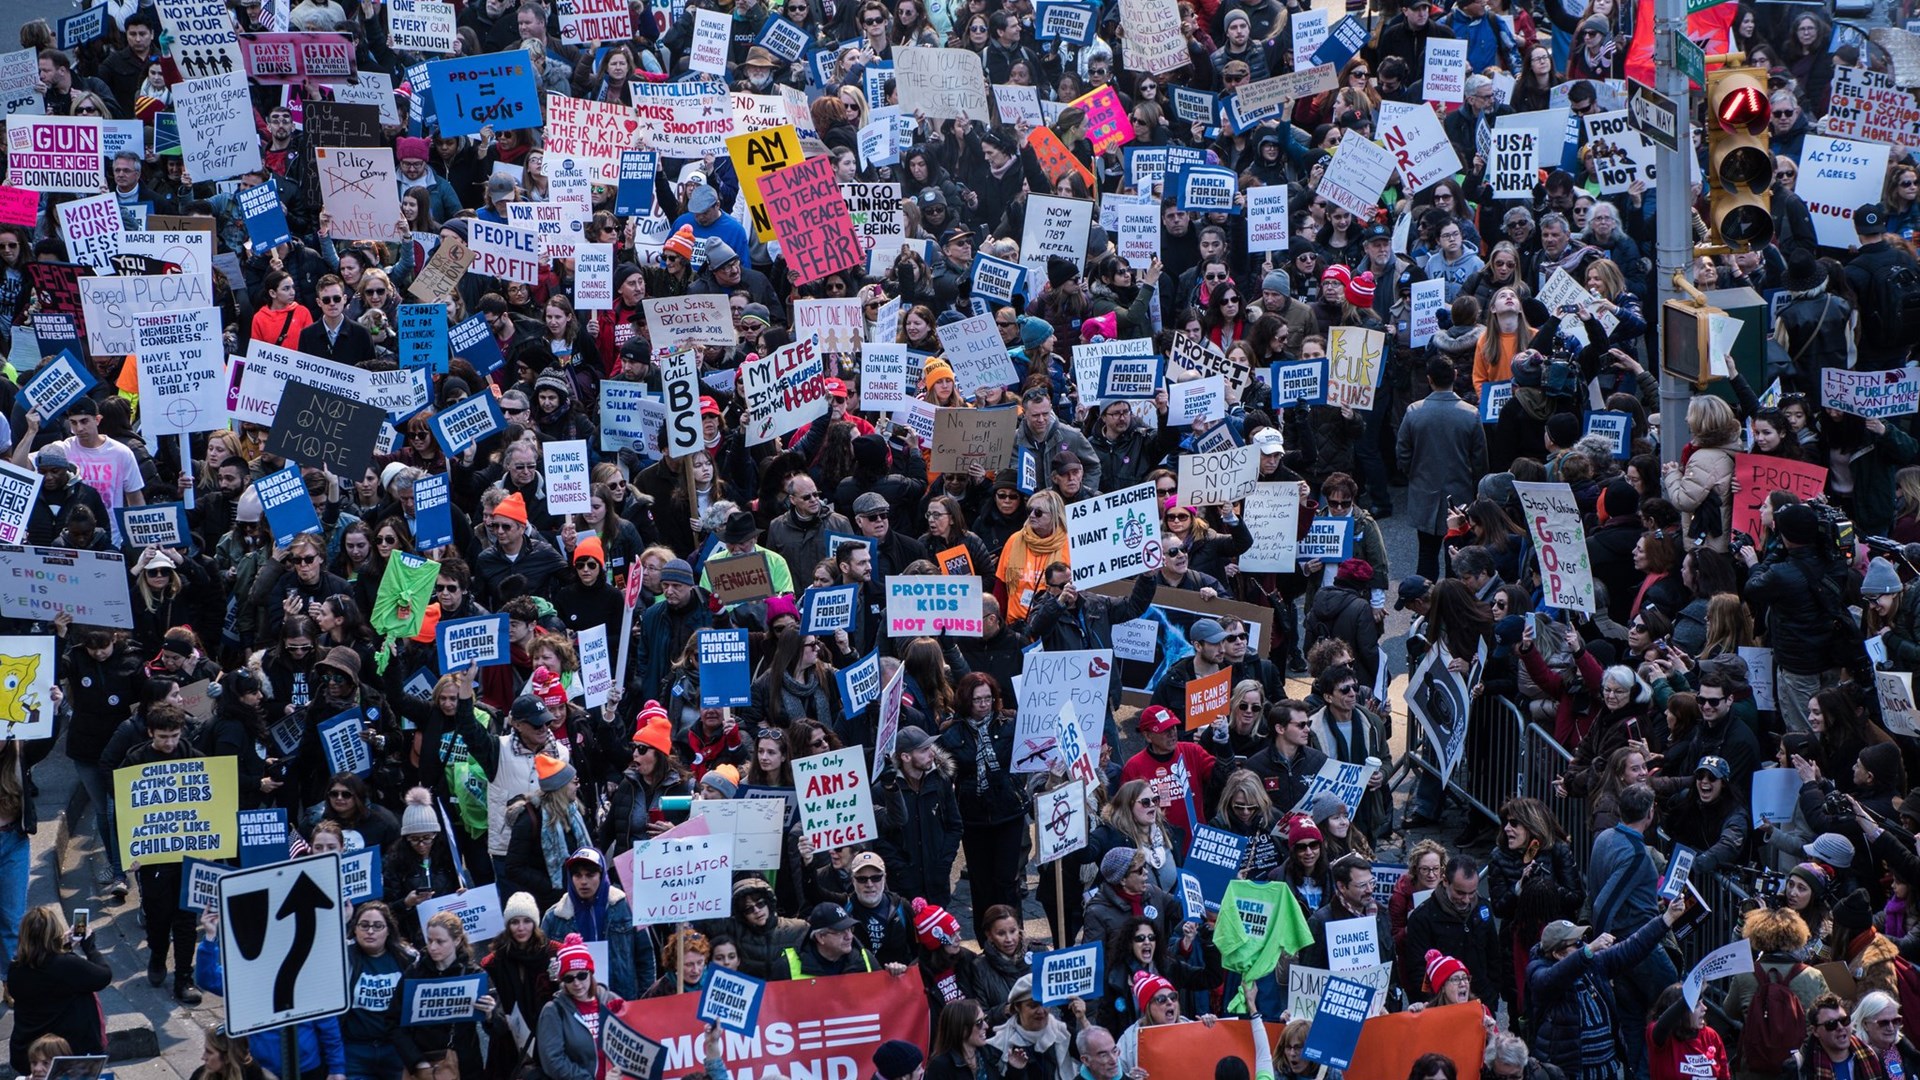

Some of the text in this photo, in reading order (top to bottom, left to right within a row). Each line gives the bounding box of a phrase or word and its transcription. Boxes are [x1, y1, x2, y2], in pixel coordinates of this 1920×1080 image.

[164, 5, 226, 19] NO PLACE
[1050, 9, 1081, 20] MARCH
[177, 19, 222, 30] IN OUR
[393, 20, 450, 33] EVERY GUN
[701, 20, 725, 30] CHANGE
[180, 32, 237, 45] SCHOOLS
[394, 35, 449, 49] #ENOUGH
[254, 43, 289, 55] GAYS
[698, 44, 721, 55] CHANGE
[1433, 48, 1460, 58] CHANGE
[257, 54, 290, 63] AGAINST
[693, 54, 724, 65] CONGRESS
[1429, 58, 1463, 68] GUN LAWS
[257, 63, 292, 73] GUNS
[189, 75, 231, 93] OWNING
[1431, 74, 1457, 83] CHANGE
[1426, 83, 1461, 92] CONGRESS
[1835, 82, 1908, 106] FEEL LUCKY
[1832, 95, 1872, 111] GO TO
[549, 109, 618, 130] THE NRA
[1635, 100, 1673, 130] ONE WAY
[1830, 106, 1908, 129] NOT LUCKY
[197, 124, 224, 141] NOT
[551, 123, 633, 145] THEIR KIDS
[1829, 118, 1893, 142] GET HOME
[34, 125, 97, 151] GUN
[652, 134, 721, 144] ARE AMERICAN
[1497, 134, 1533, 151] USA
[187, 142, 247, 162] GOD GIVEN
[544, 137, 612, 158] MORE THAN
[748, 132, 788, 165] AM
[10, 154, 98, 169] VIOLENCE
[202, 155, 236, 173] RIGHT
[1497, 153, 1532, 170] NOT
[1809, 151, 1870, 166] ACTIVIST
[25, 171, 99, 187] CONTAGIOUS
[1191, 177, 1225, 187] MARCH
[1497, 173, 1534, 191] NRA
[1817, 169, 1856, 180] AGREES
[1254, 197, 1281, 206] CHANGE
[64, 200, 117, 224] MORE
[872, 211, 895, 223] NOT
[1047, 207, 1072, 217] NOW
[1251, 206, 1284, 216] GUN LAWS
[69, 216, 120, 239] GUNS
[864, 224, 900, 235] BEING
[1044, 218, 1071, 228] IS NOT
[1254, 222, 1281, 232] CHANGE
[126, 234, 202, 243] MARCH FOR OUR
[474, 223, 534, 253] PEOPLE
[1251, 231, 1286, 241] CONGRESS
[581, 254, 606, 262] CHANGE
[471, 250, 536, 282] PROFIT
[578, 264, 592, 272] GUN
[581, 281, 606, 289] CHANGE
[578, 290, 610, 299] CONGRESS
[139, 323, 209, 336] MEMBERS OF
[142, 350, 201, 364] HAVE YOU
[669, 355, 686, 367] WE
[749, 339, 815, 387] MY LIFE
[146, 362, 189, 374] REALLY
[664, 367, 692, 382] CALL
[1114, 364, 1148, 373] MARCH
[152, 370, 215, 385] READ YOUR
[1827, 371, 1880, 386] LISTEN
[1824, 390, 1917, 406] WE WANT MORE
[1855, 385, 1894, 397] PUBLIC
[1828, 399, 1913, 417] GUN CONTROL
[674, 412, 697, 447] S
[551, 452, 580, 462] CHANGE
[1192, 448, 1247, 475] BOOKS
[548, 463, 585, 473] GUN LAWS
[1205, 468, 1238, 489] NOT
[553, 482, 581, 492] CHANGE
[550, 492, 587, 503] CONGRESS
[1071, 486, 1155, 520] AS A TEACHER
[1522, 492, 1550, 512] Stop
[129, 513, 164, 524] MARCH
[1073, 552, 1142, 582] NOT A PIECE
[12, 567, 79, 584] ENOUGH
[892, 583, 970, 597] PROTECT
[917, 599, 958, 611] KIDS
[893, 618, 982, 632] NOT GUNS!
[449, 625, 487, 641] MARCH
[701, 632, 739, 642] MARCH
[1024, 656, 1081, 687] ARMS
[1026, 689, 1105, 708] ARE FOR
[142, 762, 204, 777] CHILDREN
[799, 755, 844, 772] The Only
[1336, 764, 1362, 785] THIS
[131, 774, 209, 792] ACTING LIKE
[806, 771, 859, 798] ARMS
[131, 786, 212, 807] LEADERS
[805, 794, 856, 813] We Need
[143, 810, 197, 825] LEADERS
[807, 813, 855, 830] Are For
[133, 821, 210, 837] ACTING LIKE
[812, 823, 866, 848] HYGGE
[130, 834, 220, 857] CHILDREN
[661, 875, 705, 888] AGAINST
[671, 891, 697, 901] GUN
[648, 899, 722, 918] VIOLENCE
[1336, 930, 1369, 945] CHANGE
[1333, 942, 1375, 958] GUN LAWS
[1048, 955, 1086, 970] MARCH
[421, 987, 465, 999] MARCH
[713, 976, 745, 997] MARCH
[1328, 979, 1366, 997] MARCH
